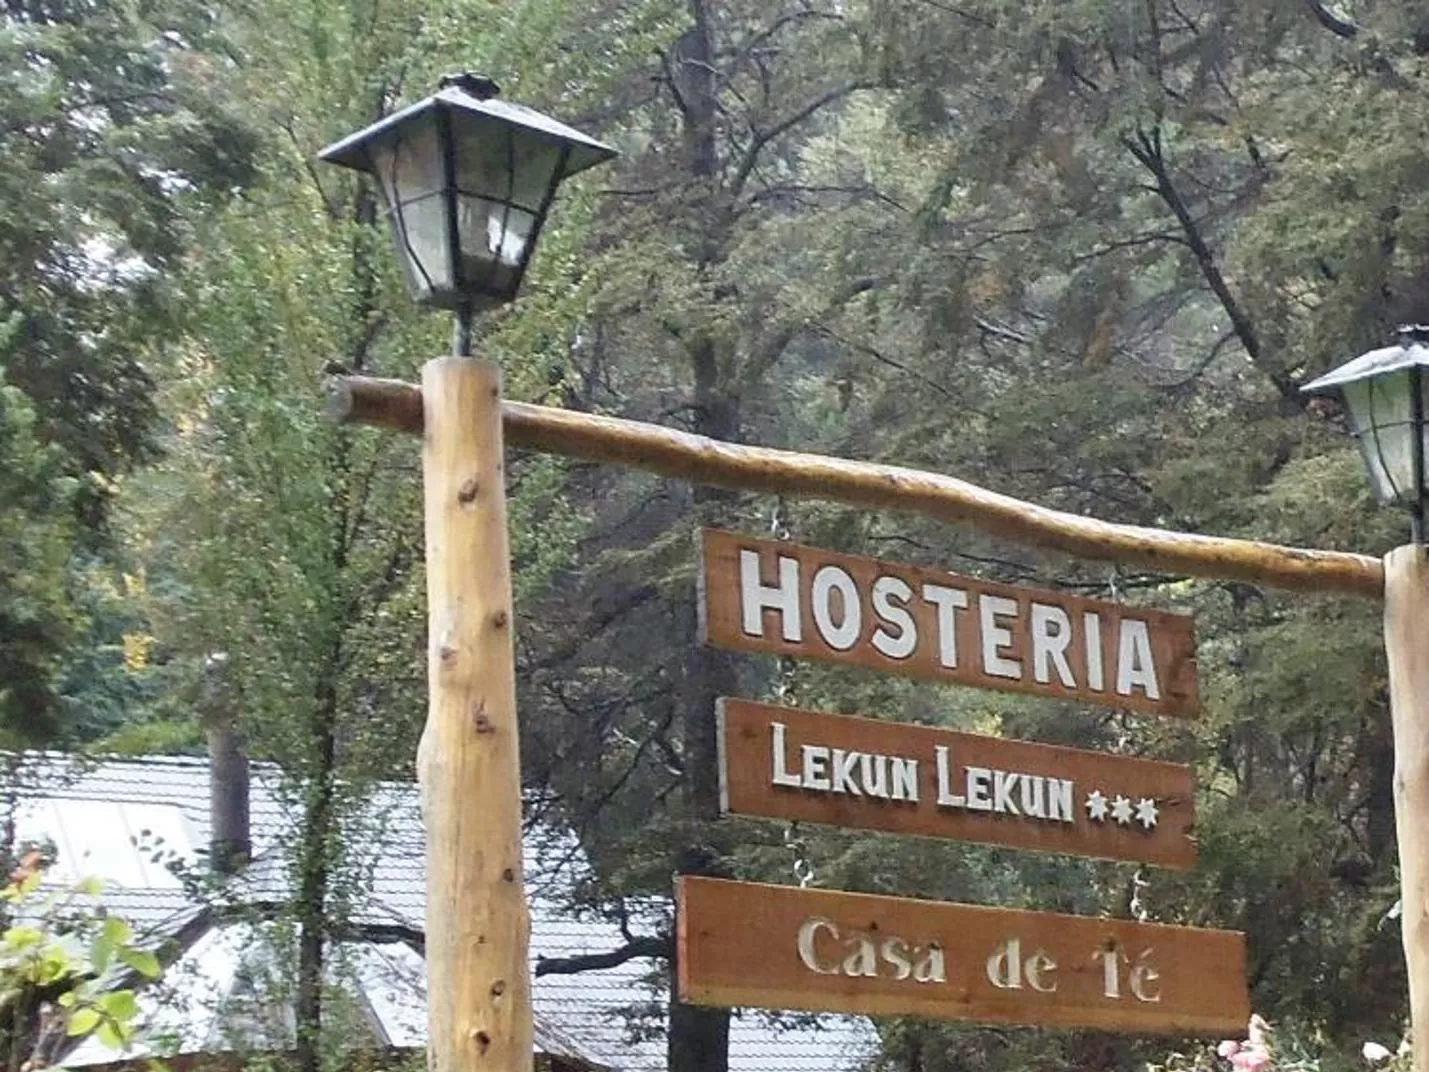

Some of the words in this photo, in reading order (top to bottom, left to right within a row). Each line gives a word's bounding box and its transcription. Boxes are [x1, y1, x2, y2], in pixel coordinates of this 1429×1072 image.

[739, 548, 1160, 700] HOSTERIA
[797, 916, 946, 983] Casa
[986, 937, 1057, 992] de
